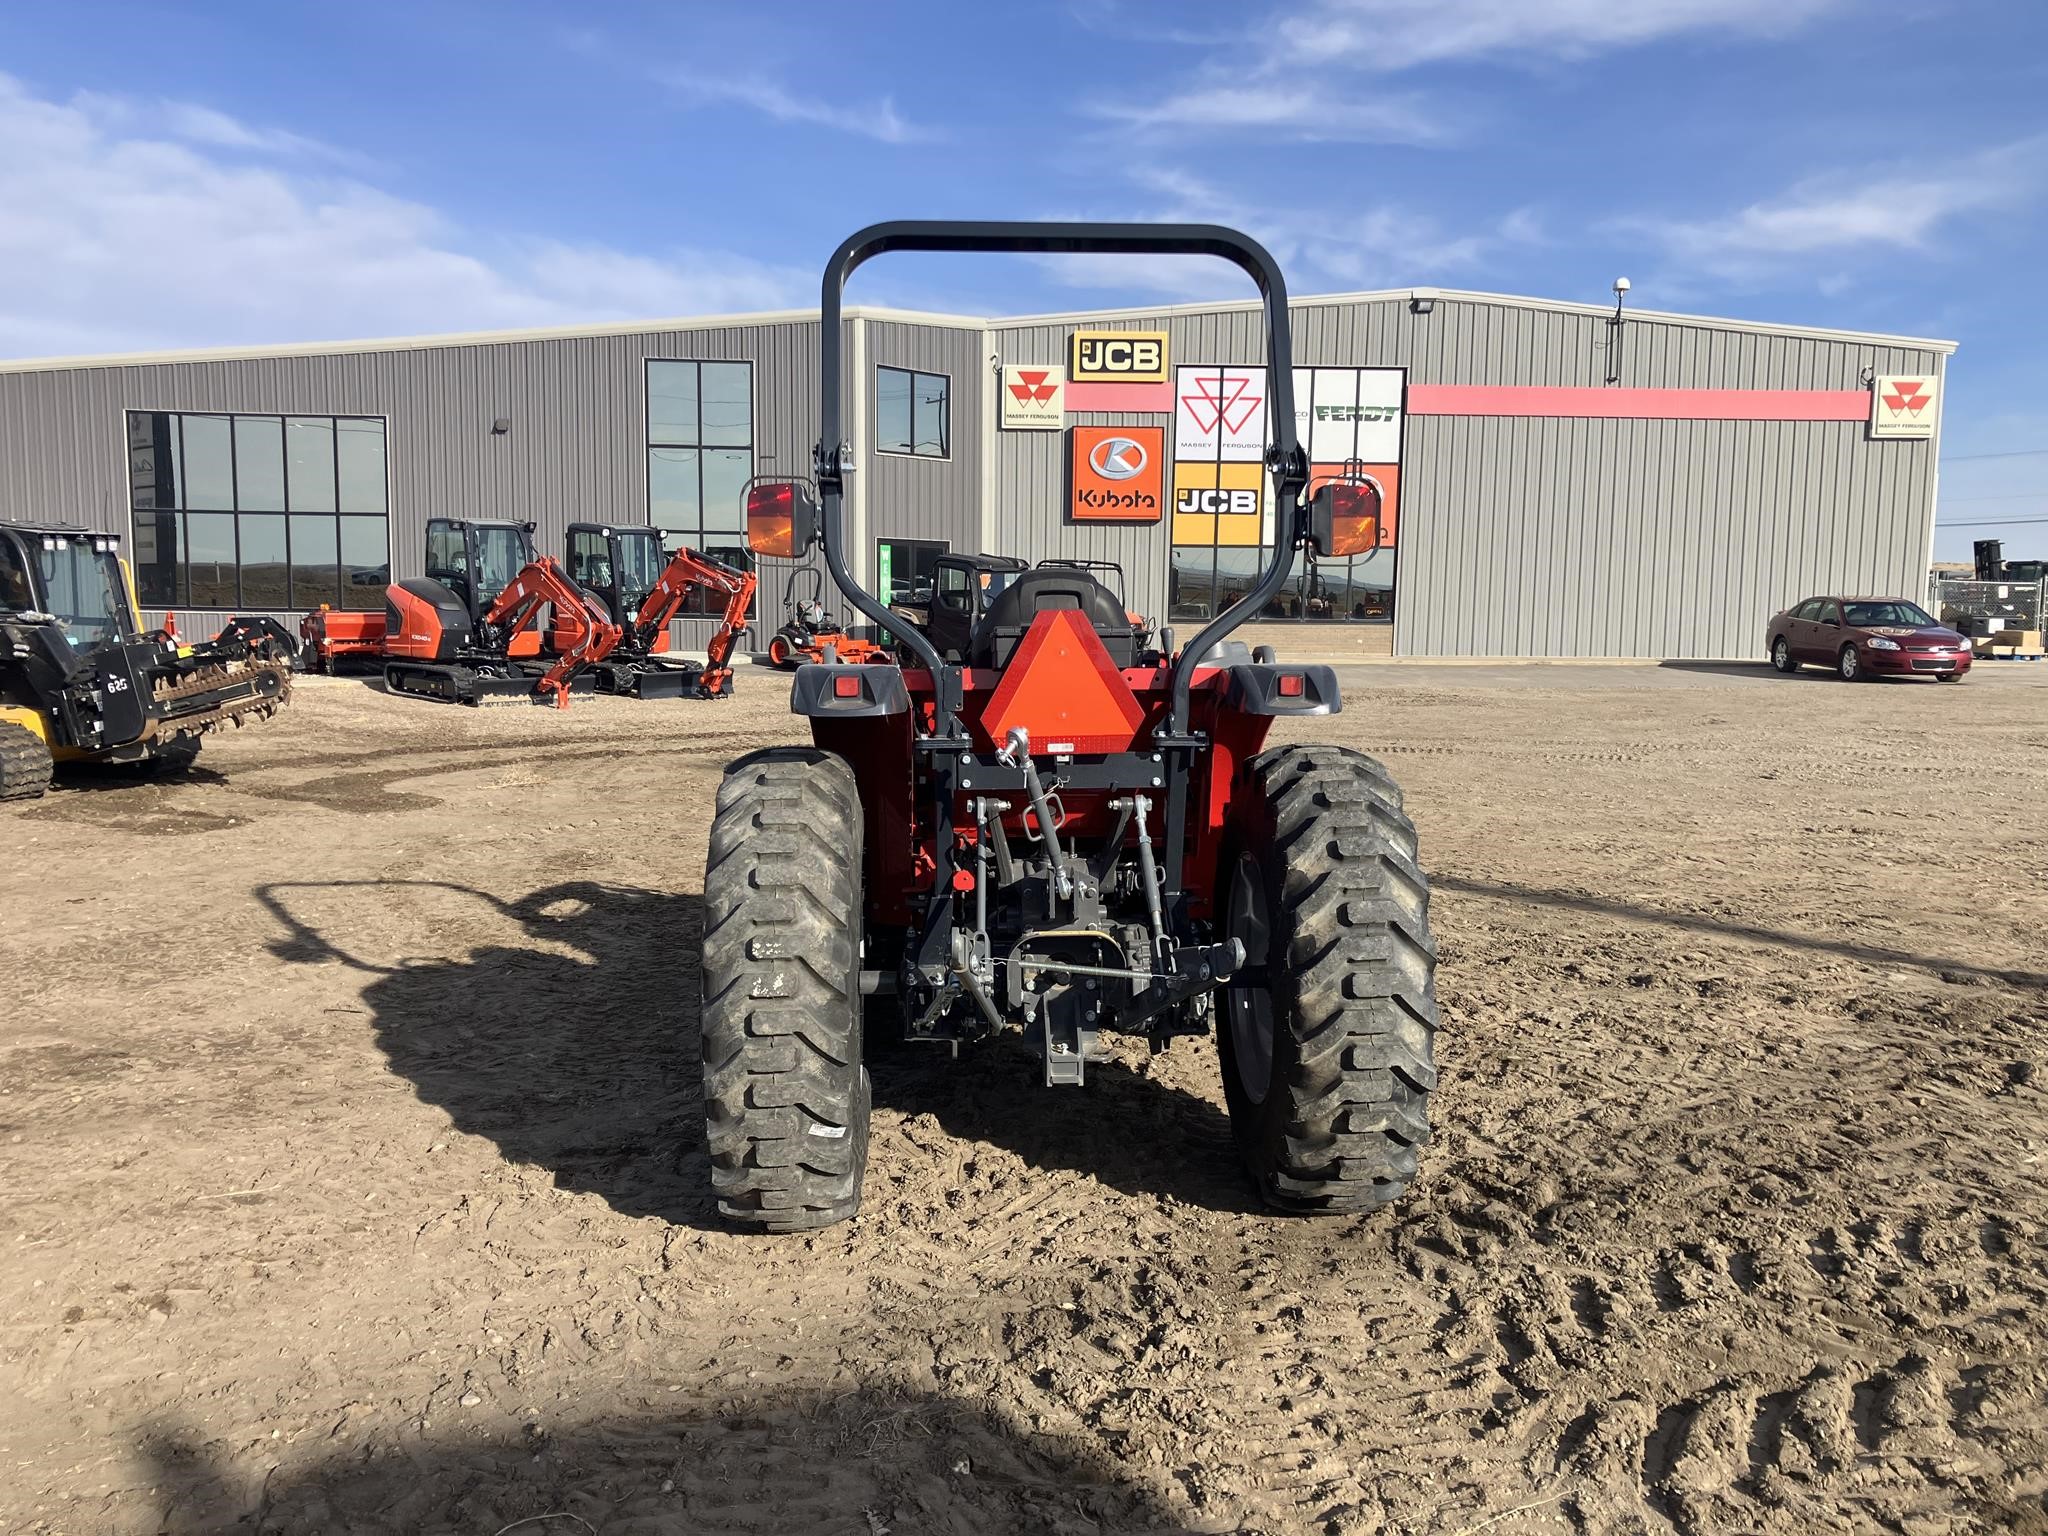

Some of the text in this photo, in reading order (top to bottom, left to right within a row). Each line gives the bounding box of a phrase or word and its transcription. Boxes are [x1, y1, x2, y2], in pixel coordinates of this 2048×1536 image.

[1081, 341, 1160, 371] JCB
[1315, 405, 1400, 422] FENDT
[1078, 489, 1155, 508] Kubota
[1178, 489, 1257, 514] JCB
